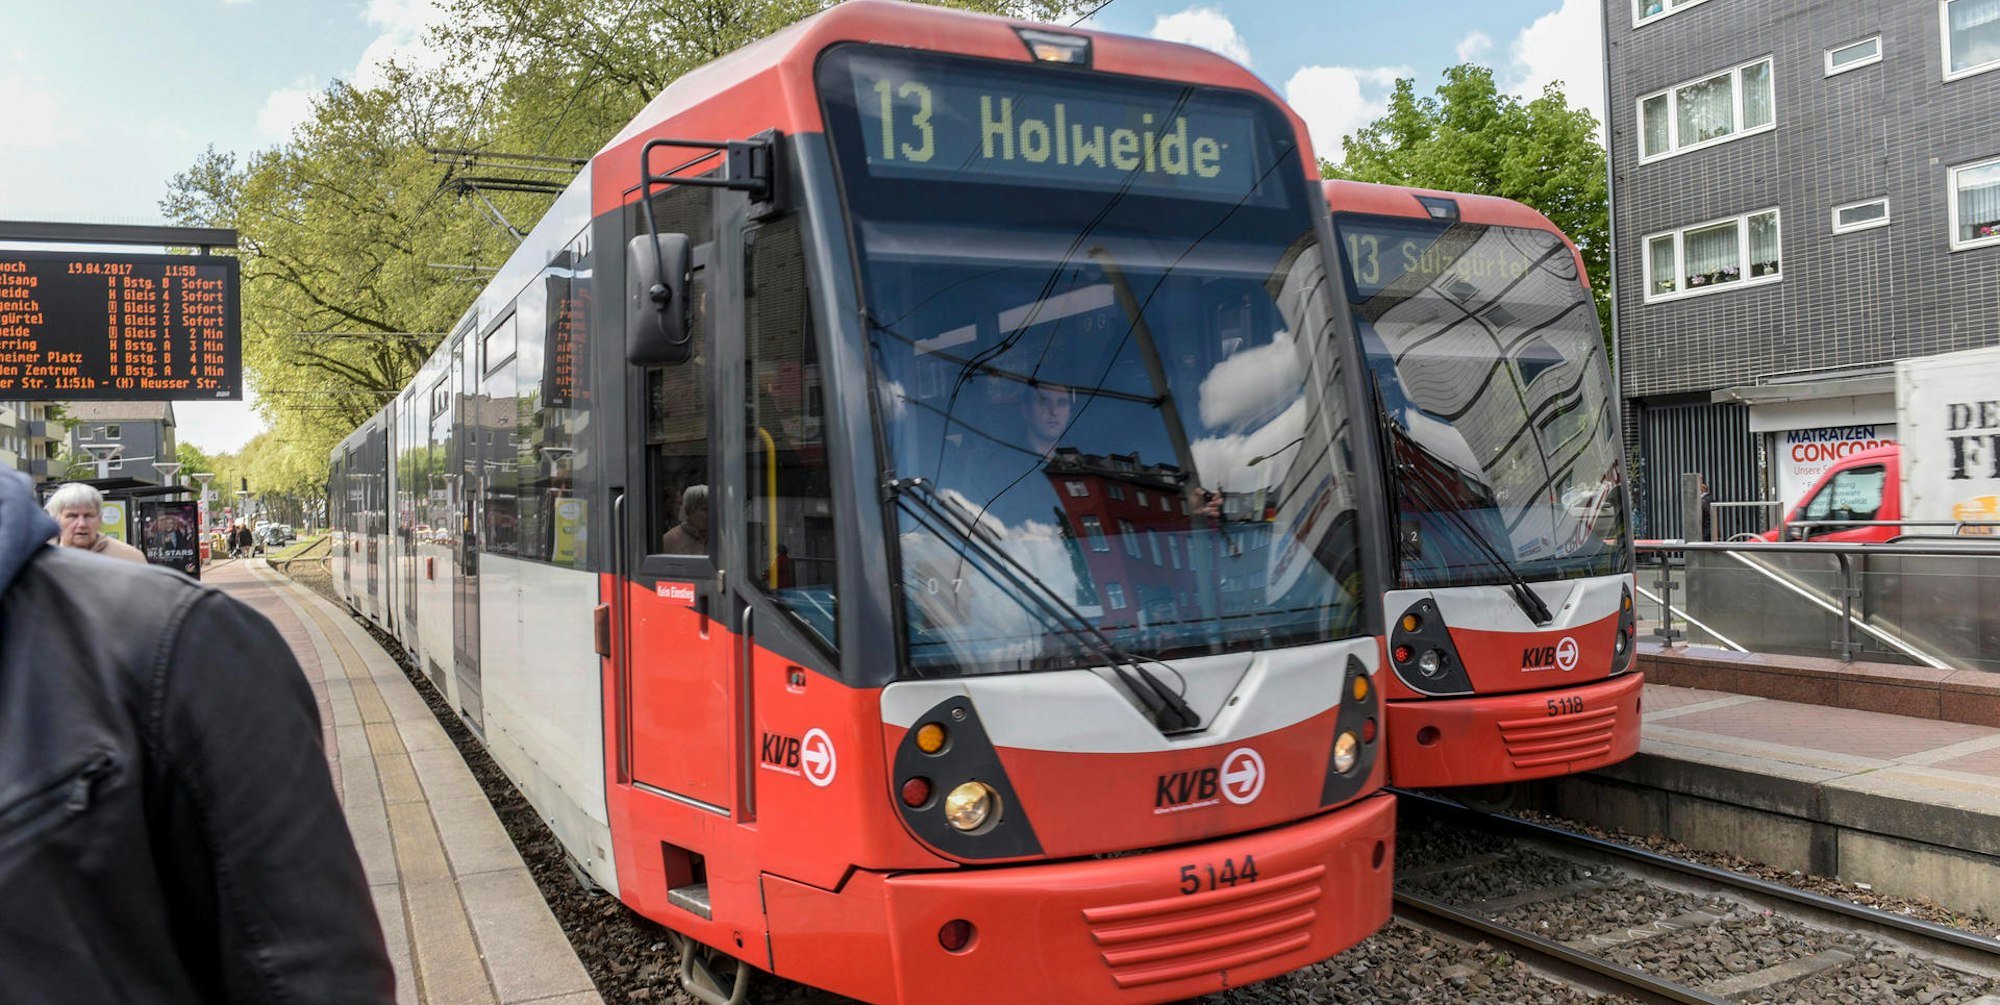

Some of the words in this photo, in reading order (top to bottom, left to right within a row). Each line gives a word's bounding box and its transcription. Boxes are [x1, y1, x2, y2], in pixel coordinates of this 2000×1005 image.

[875, 79, 934, 162] 13
[981, 95, 1221, 177] Holweide
[1349, 234, 1380, 284] 13
[68, 262, 132, 275] 19.04.2017
[165, 265, 197, 276] 11:58
[108, 276, 116, 288] H
[124, 276, 156, 290] Bstg.
[182, 278, 224, 290] Sofort
[0, 287, 30, 298] eide
[108, 288, 116, 300] H
[124, 289, 156, 301] Gleis
[162, 290, 170, 301] 4
[182, 290, 224, 302] Sofort
[124, 301, 156, 313] Gleis
[163, 302, 170, 314] 2
[182, 302, 224, 314] Sofort
[109, 314, 117, 326] H
[124, 314, 156, 326] Gleis
[163, 315, 170, 326] 3
[182, 316, 224, 327] Sofort
[125, 326, 157, 338] Gleis
[164, 327, 170, 338] 1
[189, 328, 197, 339] 2
[203, 328, 224, 340] Min
[0, 338, 37, 352] rring
[110, 340, 118, 351] H
[125, 340, 157, 352] Bstg.
[164, 340, 172, 352] A
[190, 340, 197, 352] 3
[204, 340, 224, 352] Min
[48, 352, 83, 364] Platz
[110, 352, 118, 364] H
[126, 352, 158, 365] Bstg.
[190, 353, 197, 364] 4
[204, 353, 224, 364] Min
[25, 364, 78, 376] Zentrum
[110, 364, 118, 376] H
[126, 364, 158, 378] Bstg.
[164, 365, 172, 376] A
[190, 365, 197, 376] 4
[204, 365, 224, 376] Min
[22, 377, 48, 389] Str.
[54, 377, 95, 389] 11:51h
[141, 378, 190, 390] Neusser
[196, 378, 222, 390] Str.
[1787, 425, 1876, 443] MATRATZEN
[1794, 466, 1821, 475] Unsere
[952, 578, 962, 593] 7
[1522, 646, 1557, 669] KVB
[1547, 696, 1584, 717] 5118
[762, 732, 801, 768] KVB
[1155, 767, 1219, 807] KVB
[1180, 854, 1259, 895] 5144
